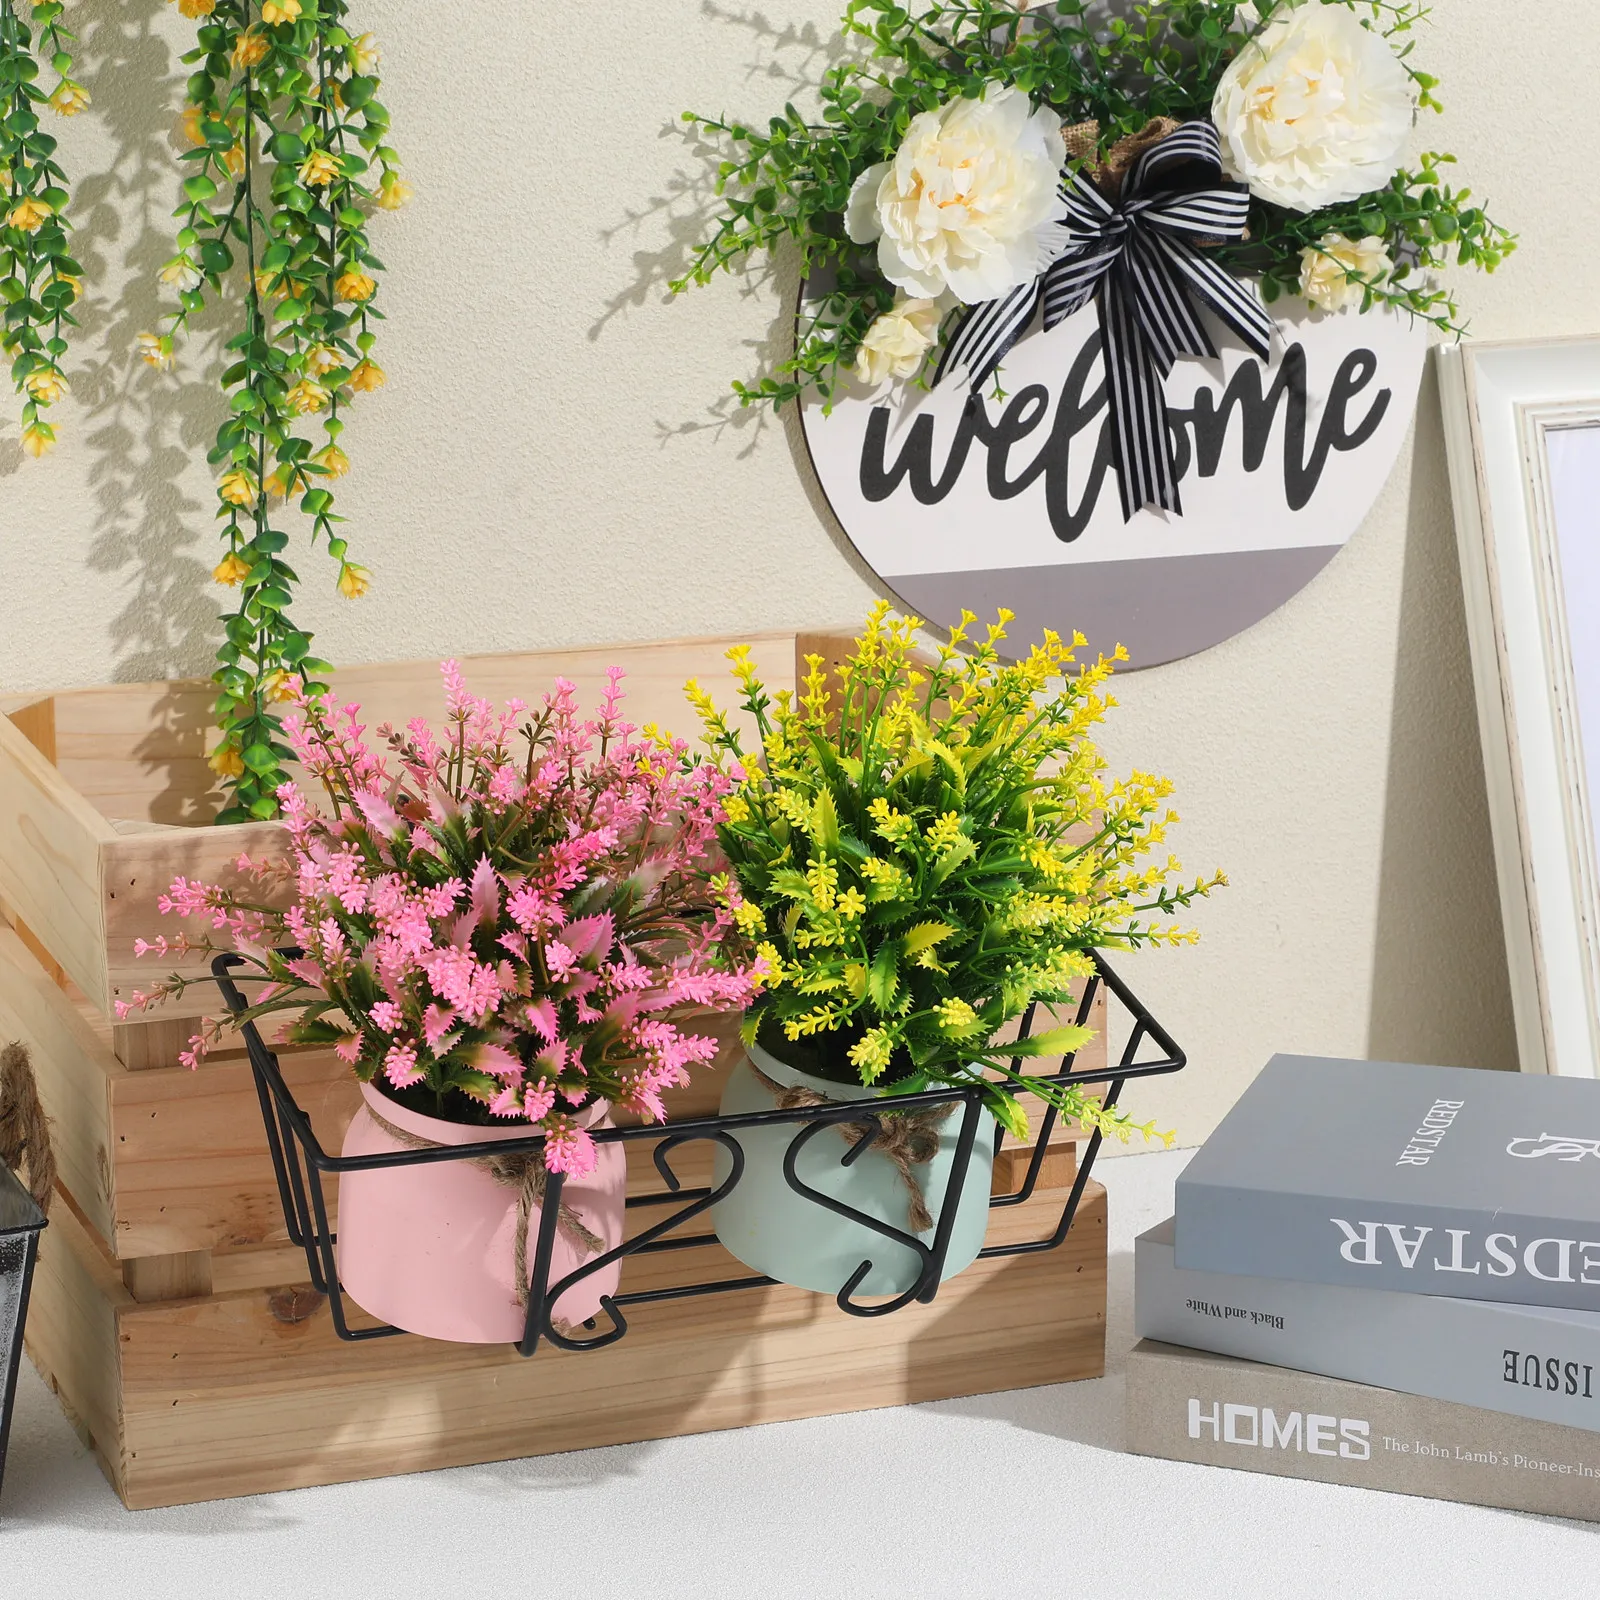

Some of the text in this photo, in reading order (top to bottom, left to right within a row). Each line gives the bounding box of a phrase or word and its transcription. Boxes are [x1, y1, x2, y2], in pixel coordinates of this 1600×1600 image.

[1396, 1099, 1465, 1167] REDSTAR
[1186, 1299, 1285, 1330] Black and White
[1503, 1349, 1593, 1398] ISSUE
[1188, 1398, 1370, 1461] HOMES
[1382, 1436, 1410, 1453] The
[1413, 1440, 1449, 1459] John
[1455, 1446, 1509, 1466] Lamb's
